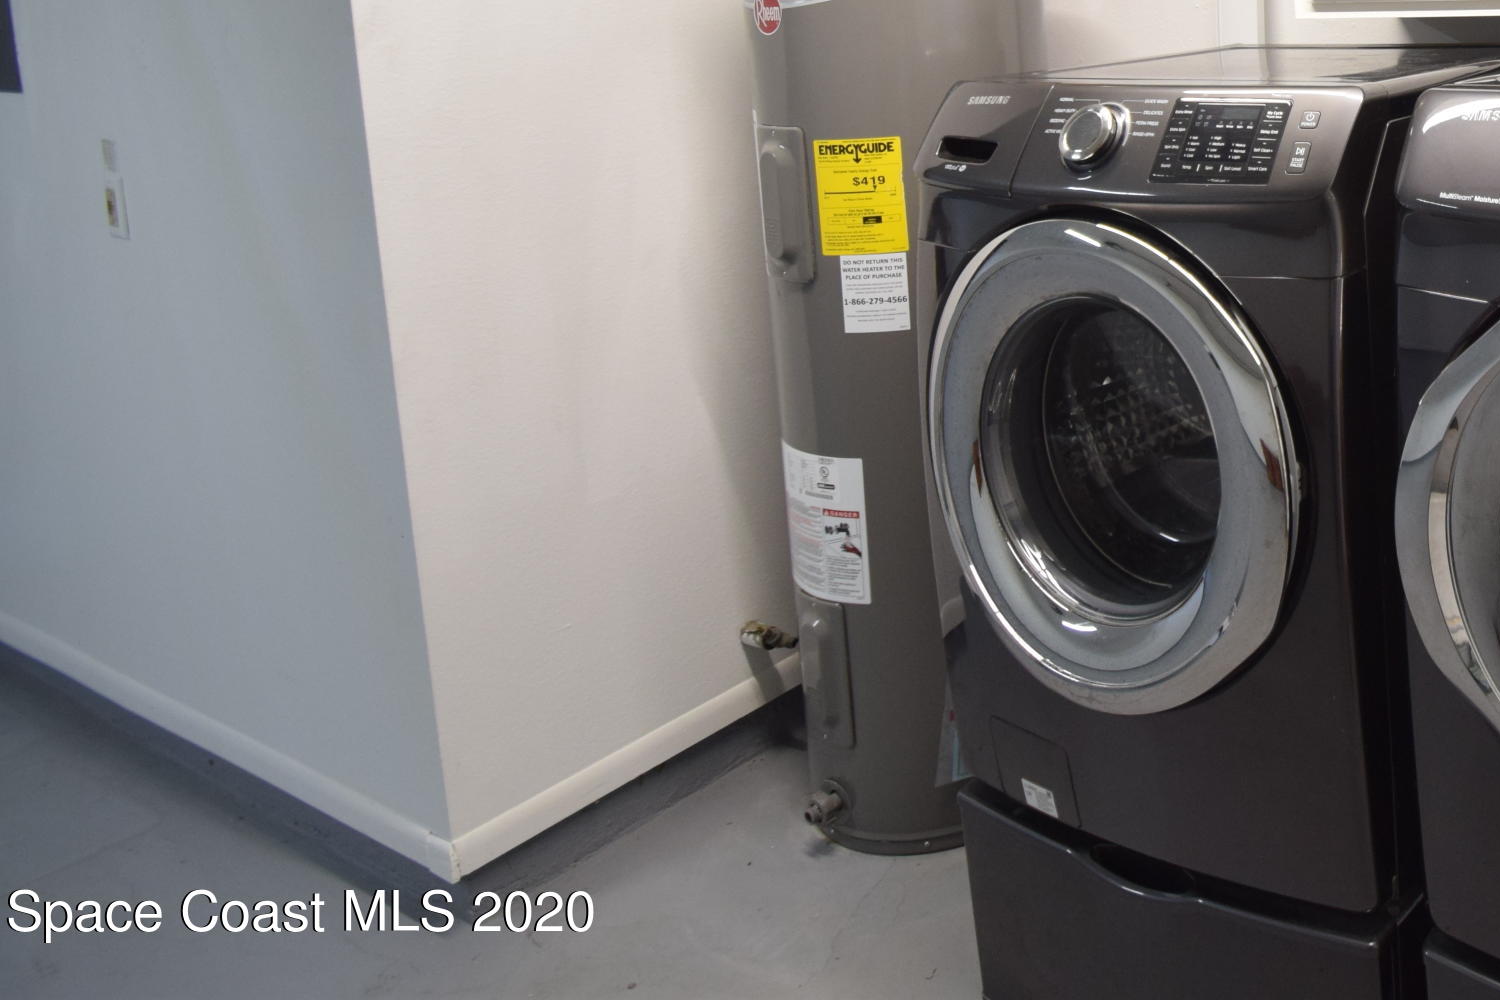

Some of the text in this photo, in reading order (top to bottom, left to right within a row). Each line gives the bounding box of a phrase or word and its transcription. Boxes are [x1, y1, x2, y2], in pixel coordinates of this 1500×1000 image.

[967, 95, 1011, 105] SAMSUNG
[818, 142, 895, 157] ENERGYGUIDE
[851, 175, 886, 187] $419
[843, 295, 908, 306] 1-866-279-4566
